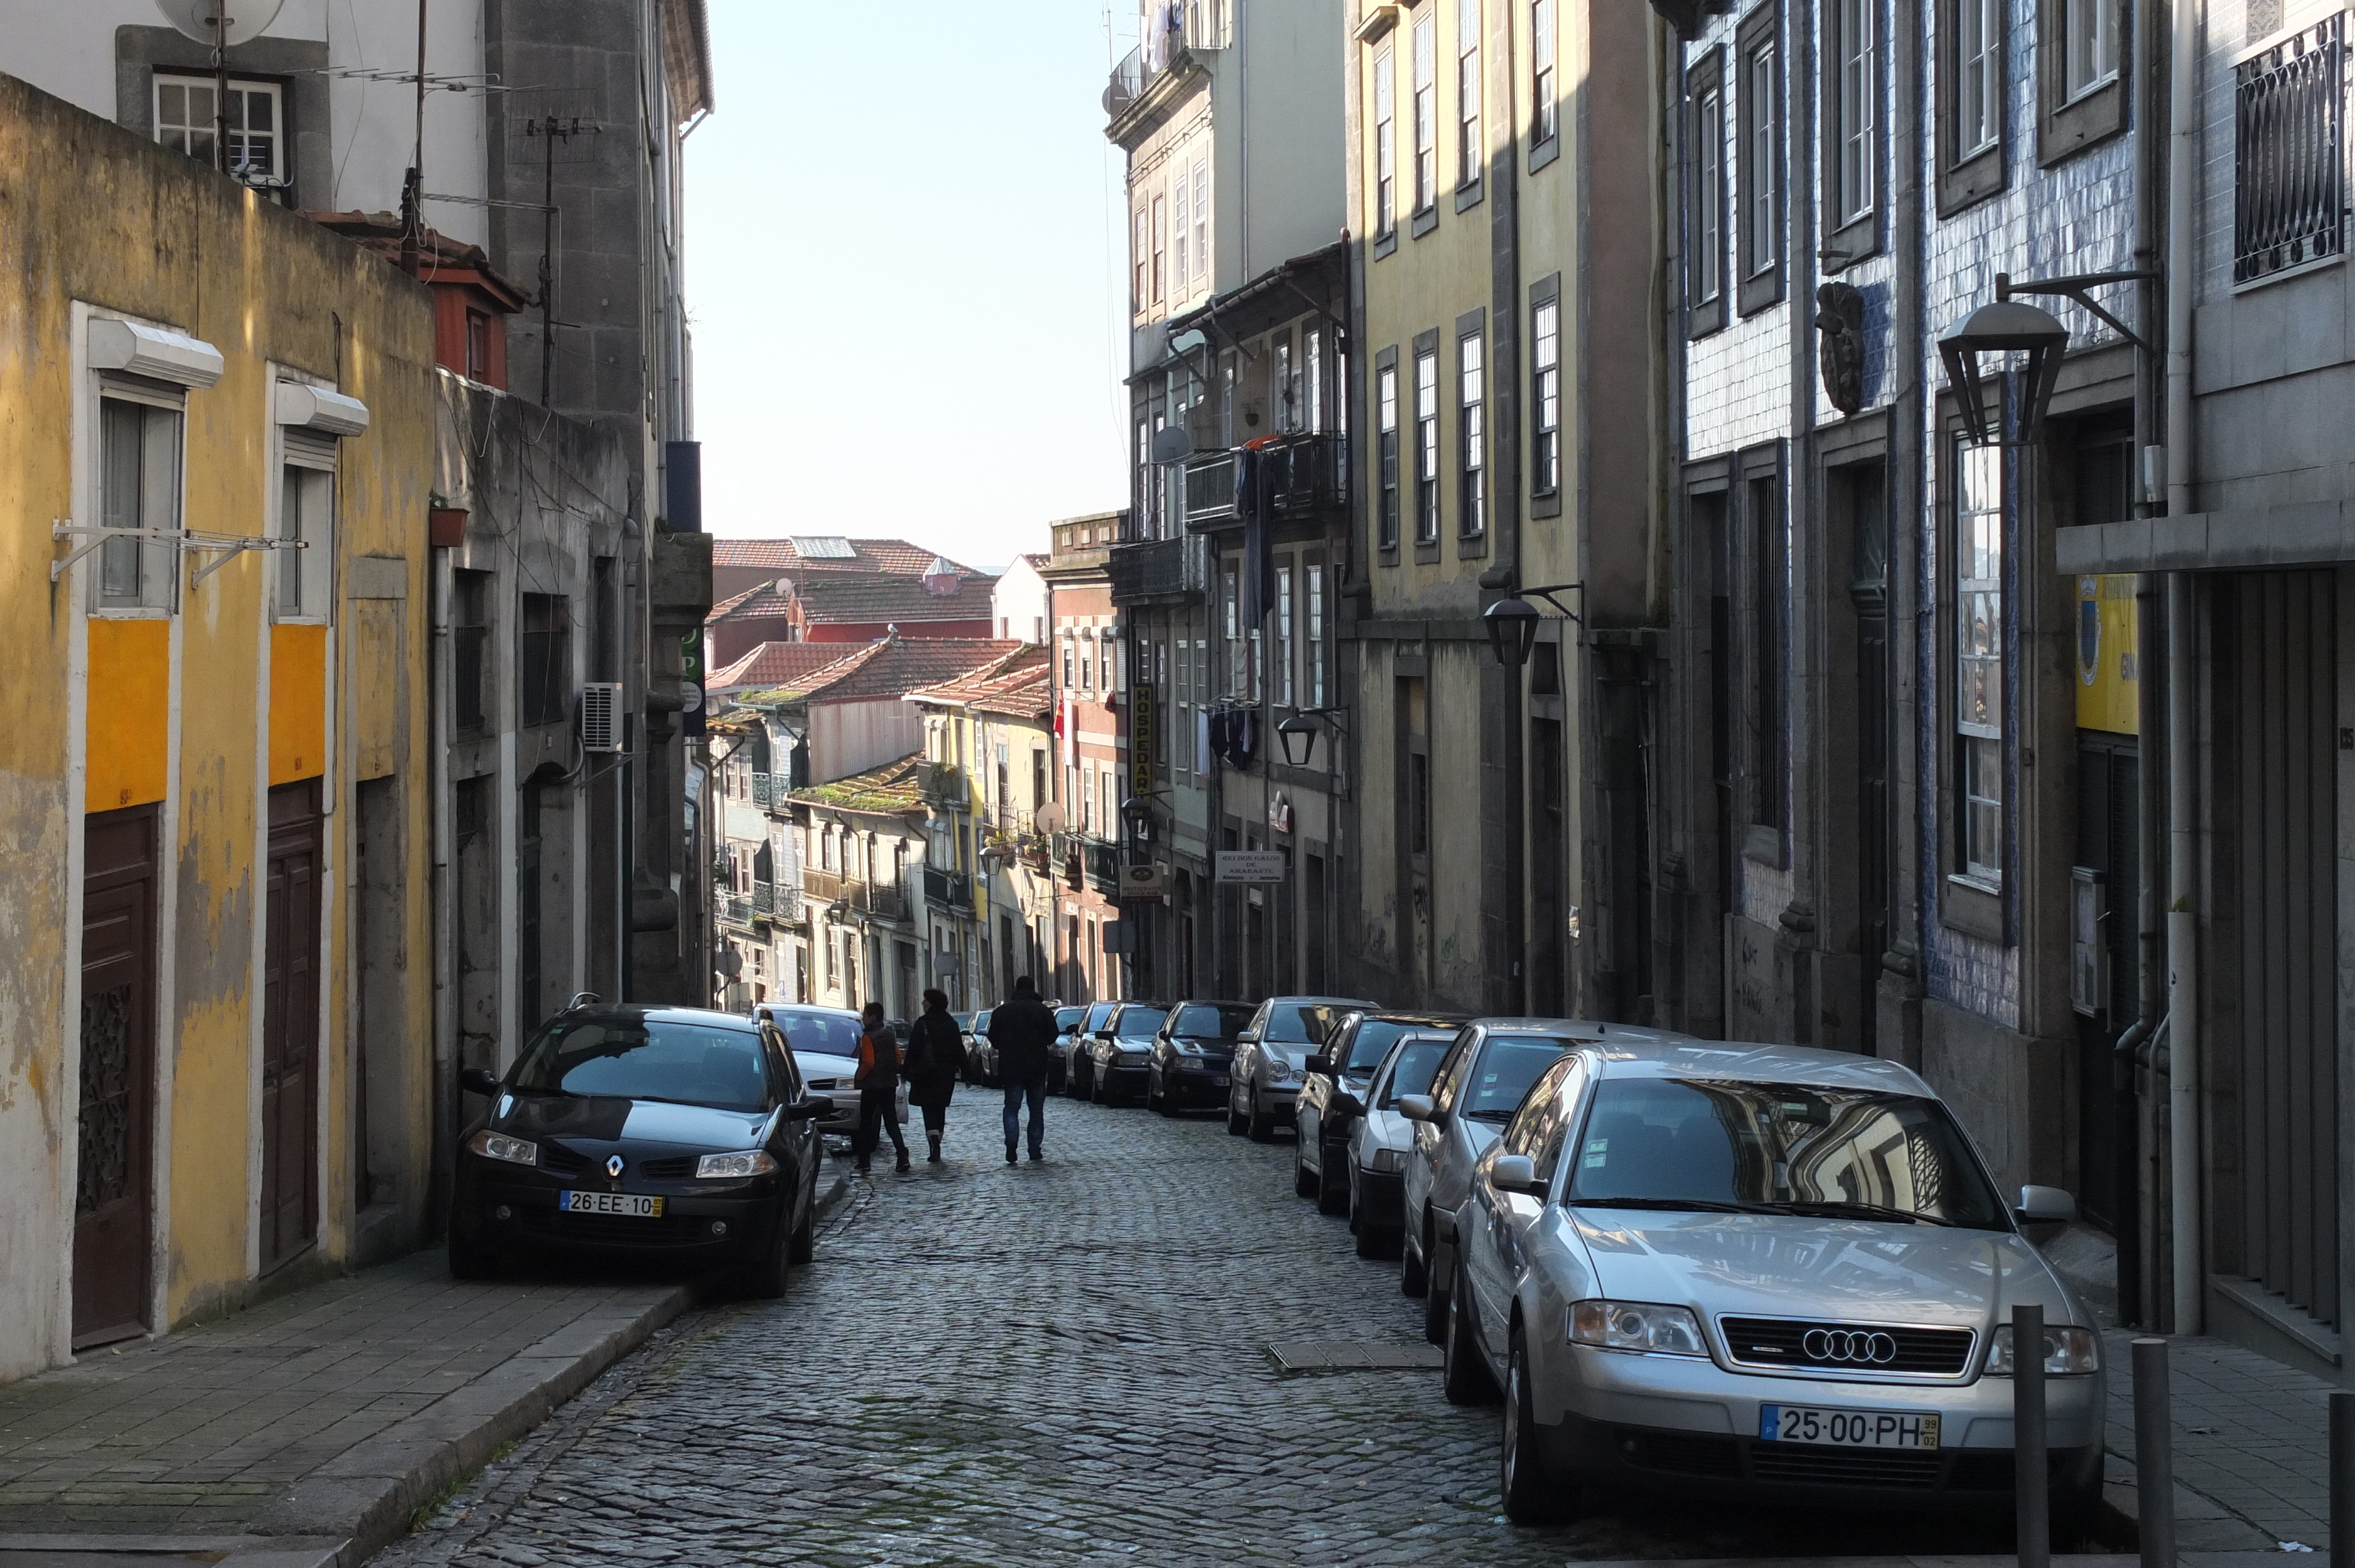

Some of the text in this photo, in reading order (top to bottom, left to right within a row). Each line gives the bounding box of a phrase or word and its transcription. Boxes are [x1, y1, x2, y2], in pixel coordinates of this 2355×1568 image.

[1137, 690, 1148, 799] HOSPEDAR
[1924, 1419, 1936, 1429] 99
[1923, 1436, 1936, 1446] 02
